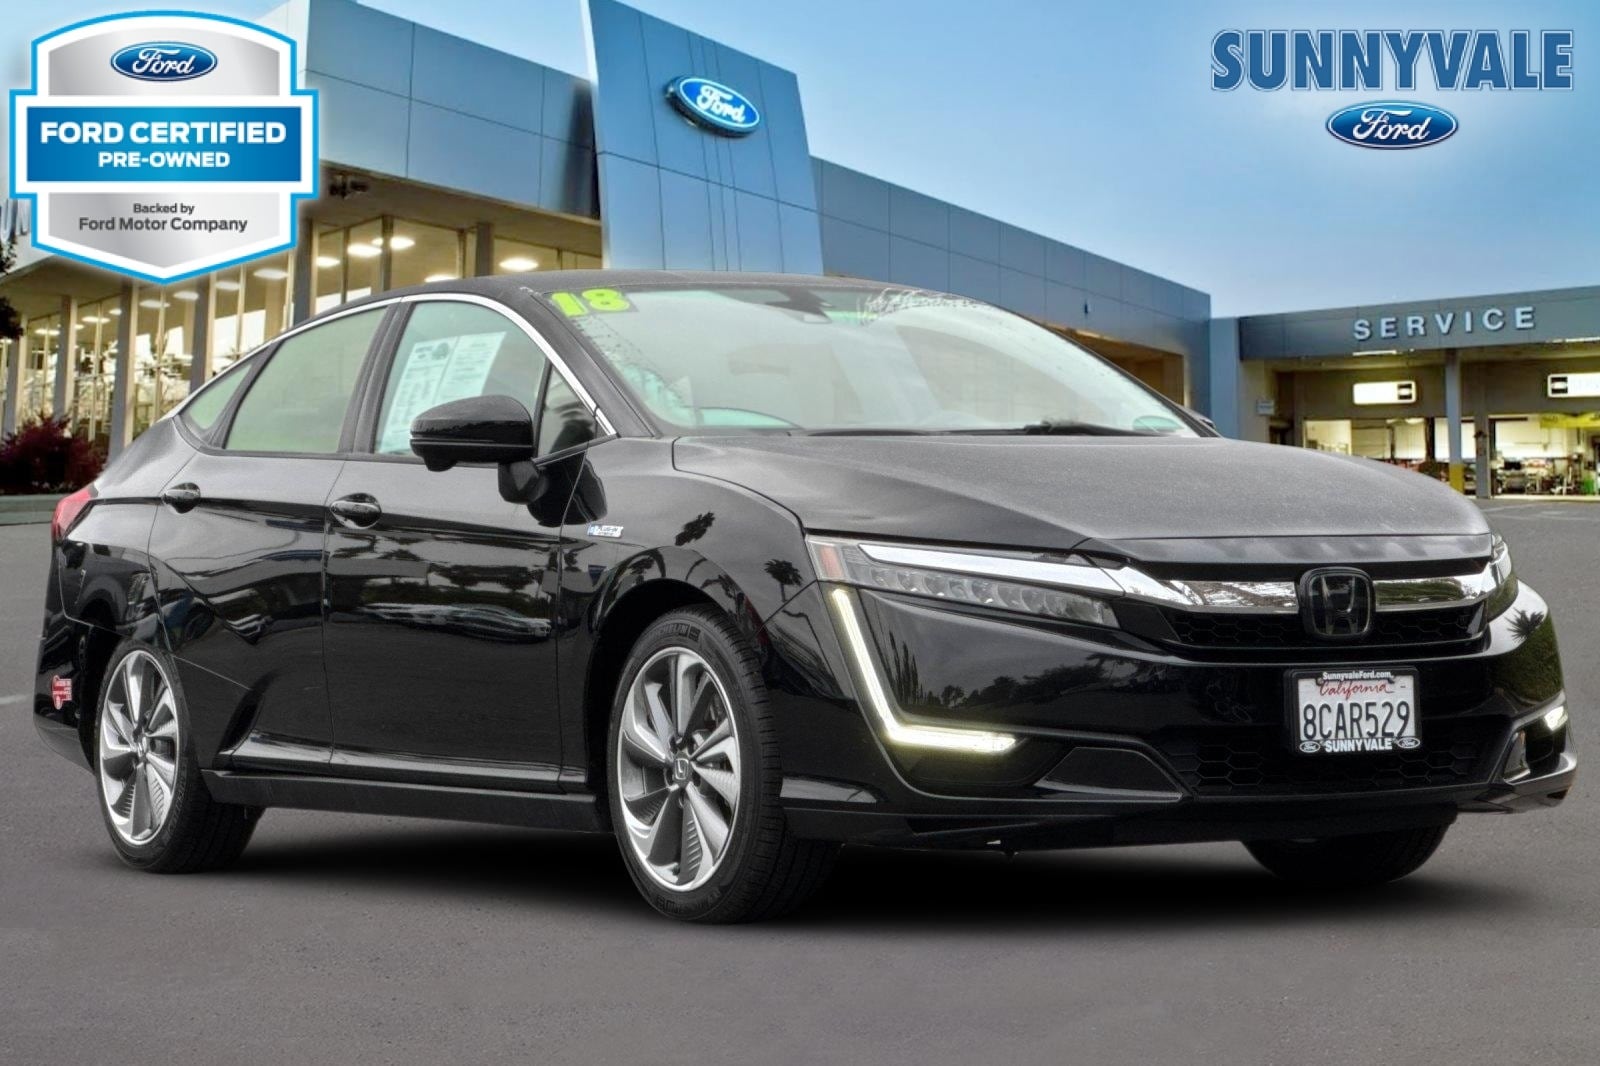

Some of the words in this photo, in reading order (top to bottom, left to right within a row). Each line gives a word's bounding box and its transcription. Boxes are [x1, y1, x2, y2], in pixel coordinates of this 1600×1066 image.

[696, 85, 746, 122] Ford
[551, 288, 630, 318] 18
[1353, 306, 1536, 341] SERVICE
[1320, 680, 1394, 700] California
[1303, 701, 1411, 740] 8CAR529
[1325, 738, 1392, 753] SUNNYVALE
